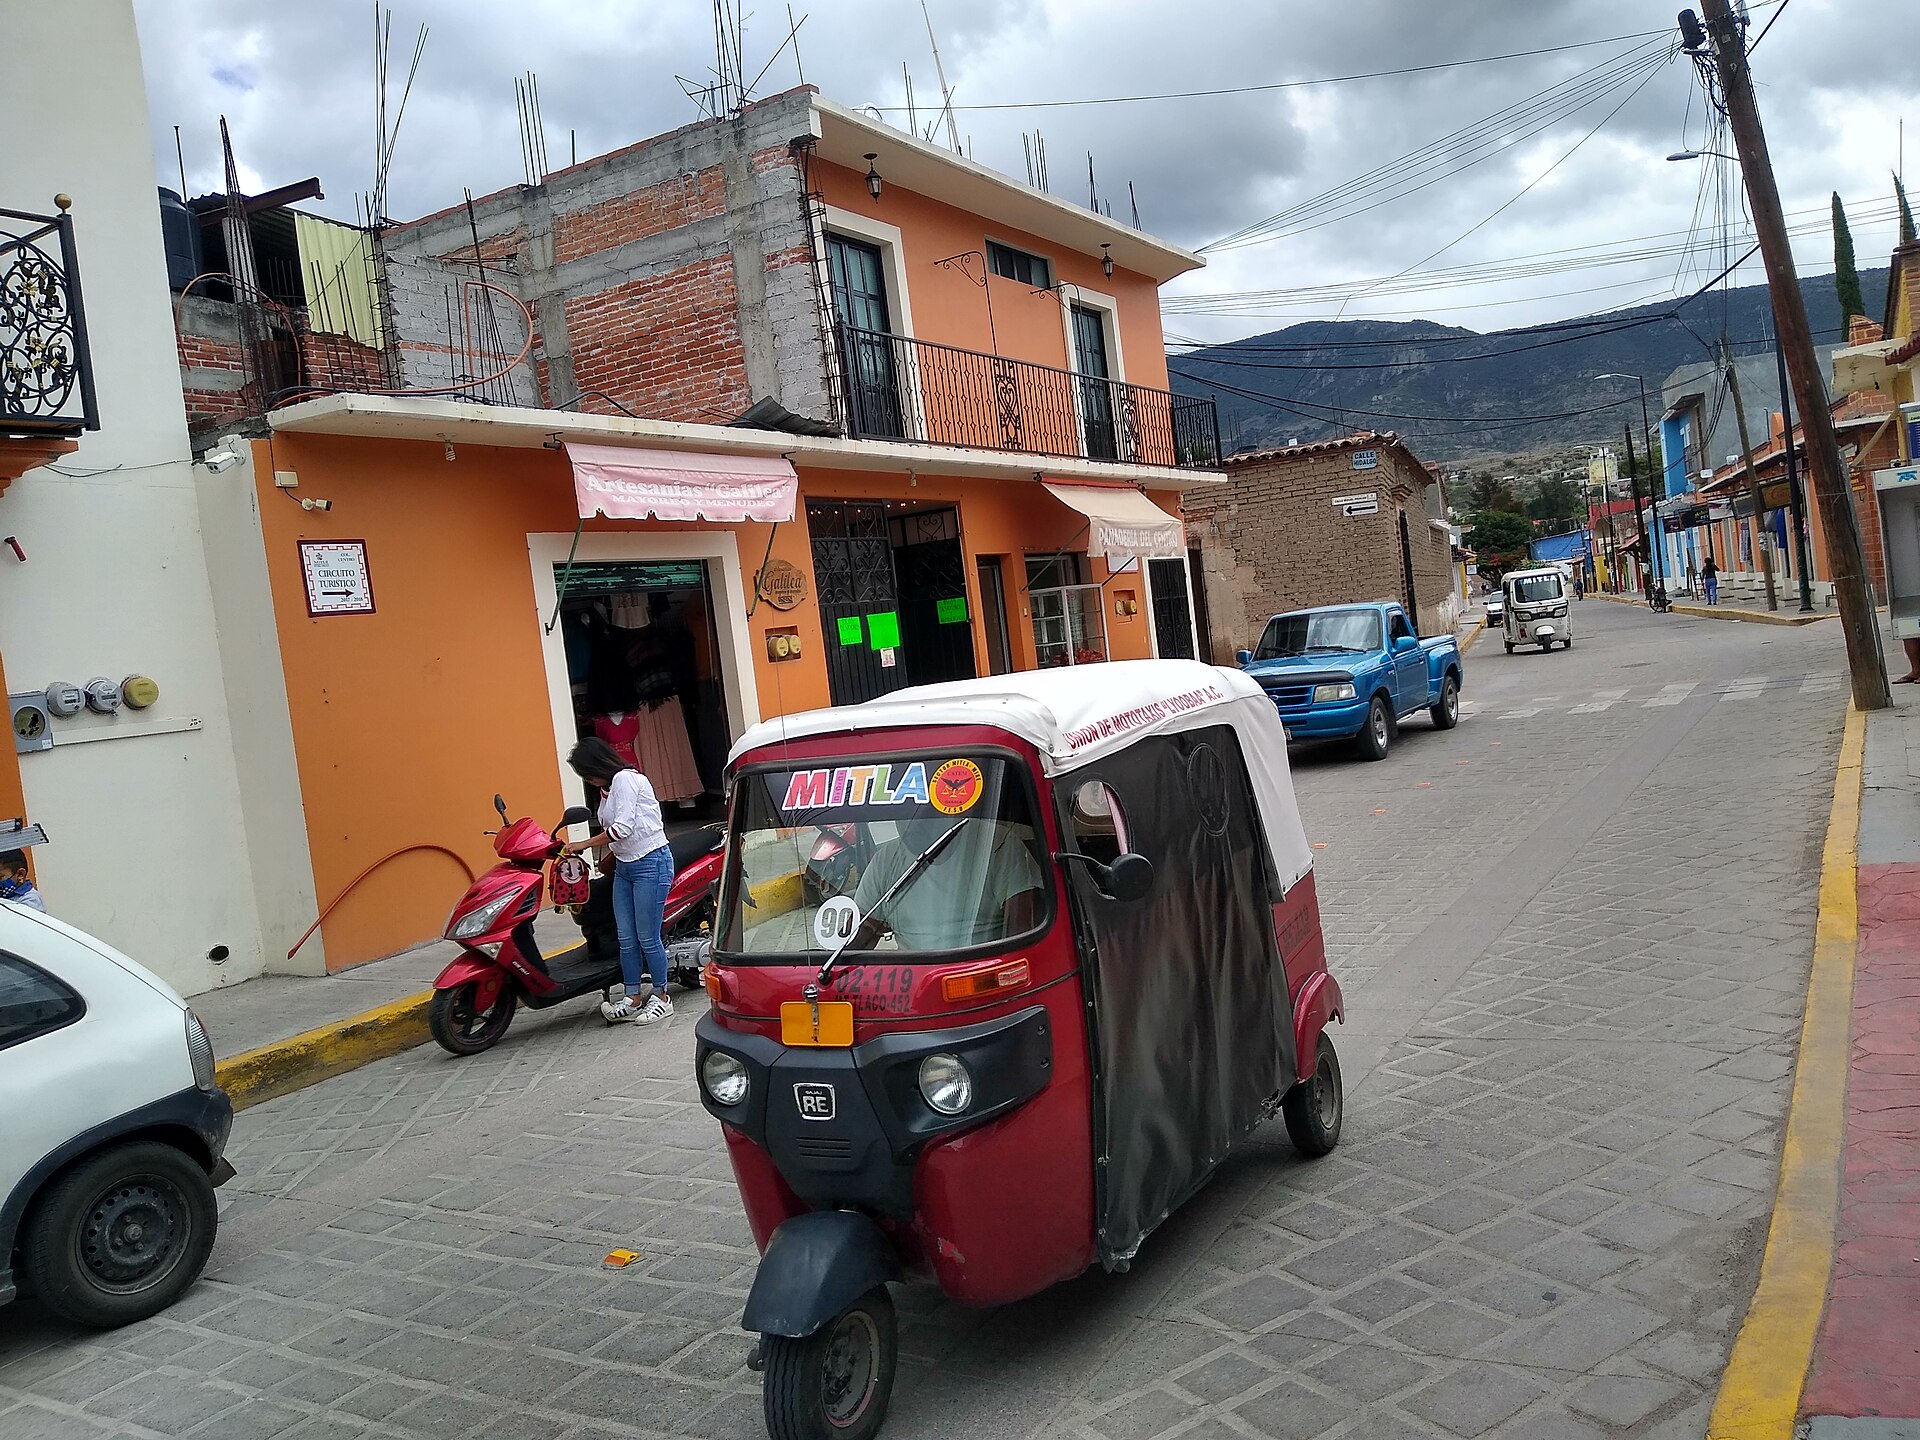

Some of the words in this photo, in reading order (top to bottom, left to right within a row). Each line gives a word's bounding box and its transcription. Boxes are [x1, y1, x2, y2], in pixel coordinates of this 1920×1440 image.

[1353, 458, 1377, 466] HIDALGO
[1354, 451, 1375, 459] CALLE
[611, 494, 691, 506] MAYOREO
[705, 498, 776, 508] MENUDEO
[1139, 530, 1153, 547] DEL
[318, 569, 355, 578] CIRCUITO
[762, 570, 801, 595] Galilea
[1523, 574, 1558, 585] MITLA
[1098, 718, 1115, 738] DE
[1111, 702, 1166, 733] MOTOTAXIS
[1202, 685, 1225, 702] A.C.
[931, 763, 951, 784] SECTOR
[782, 763, 930, 810] MITLA
[820, 907, 854, 938] 90
[835, 966, 913, 993] 02-119
[802, 1095, 829, 1113] RE
